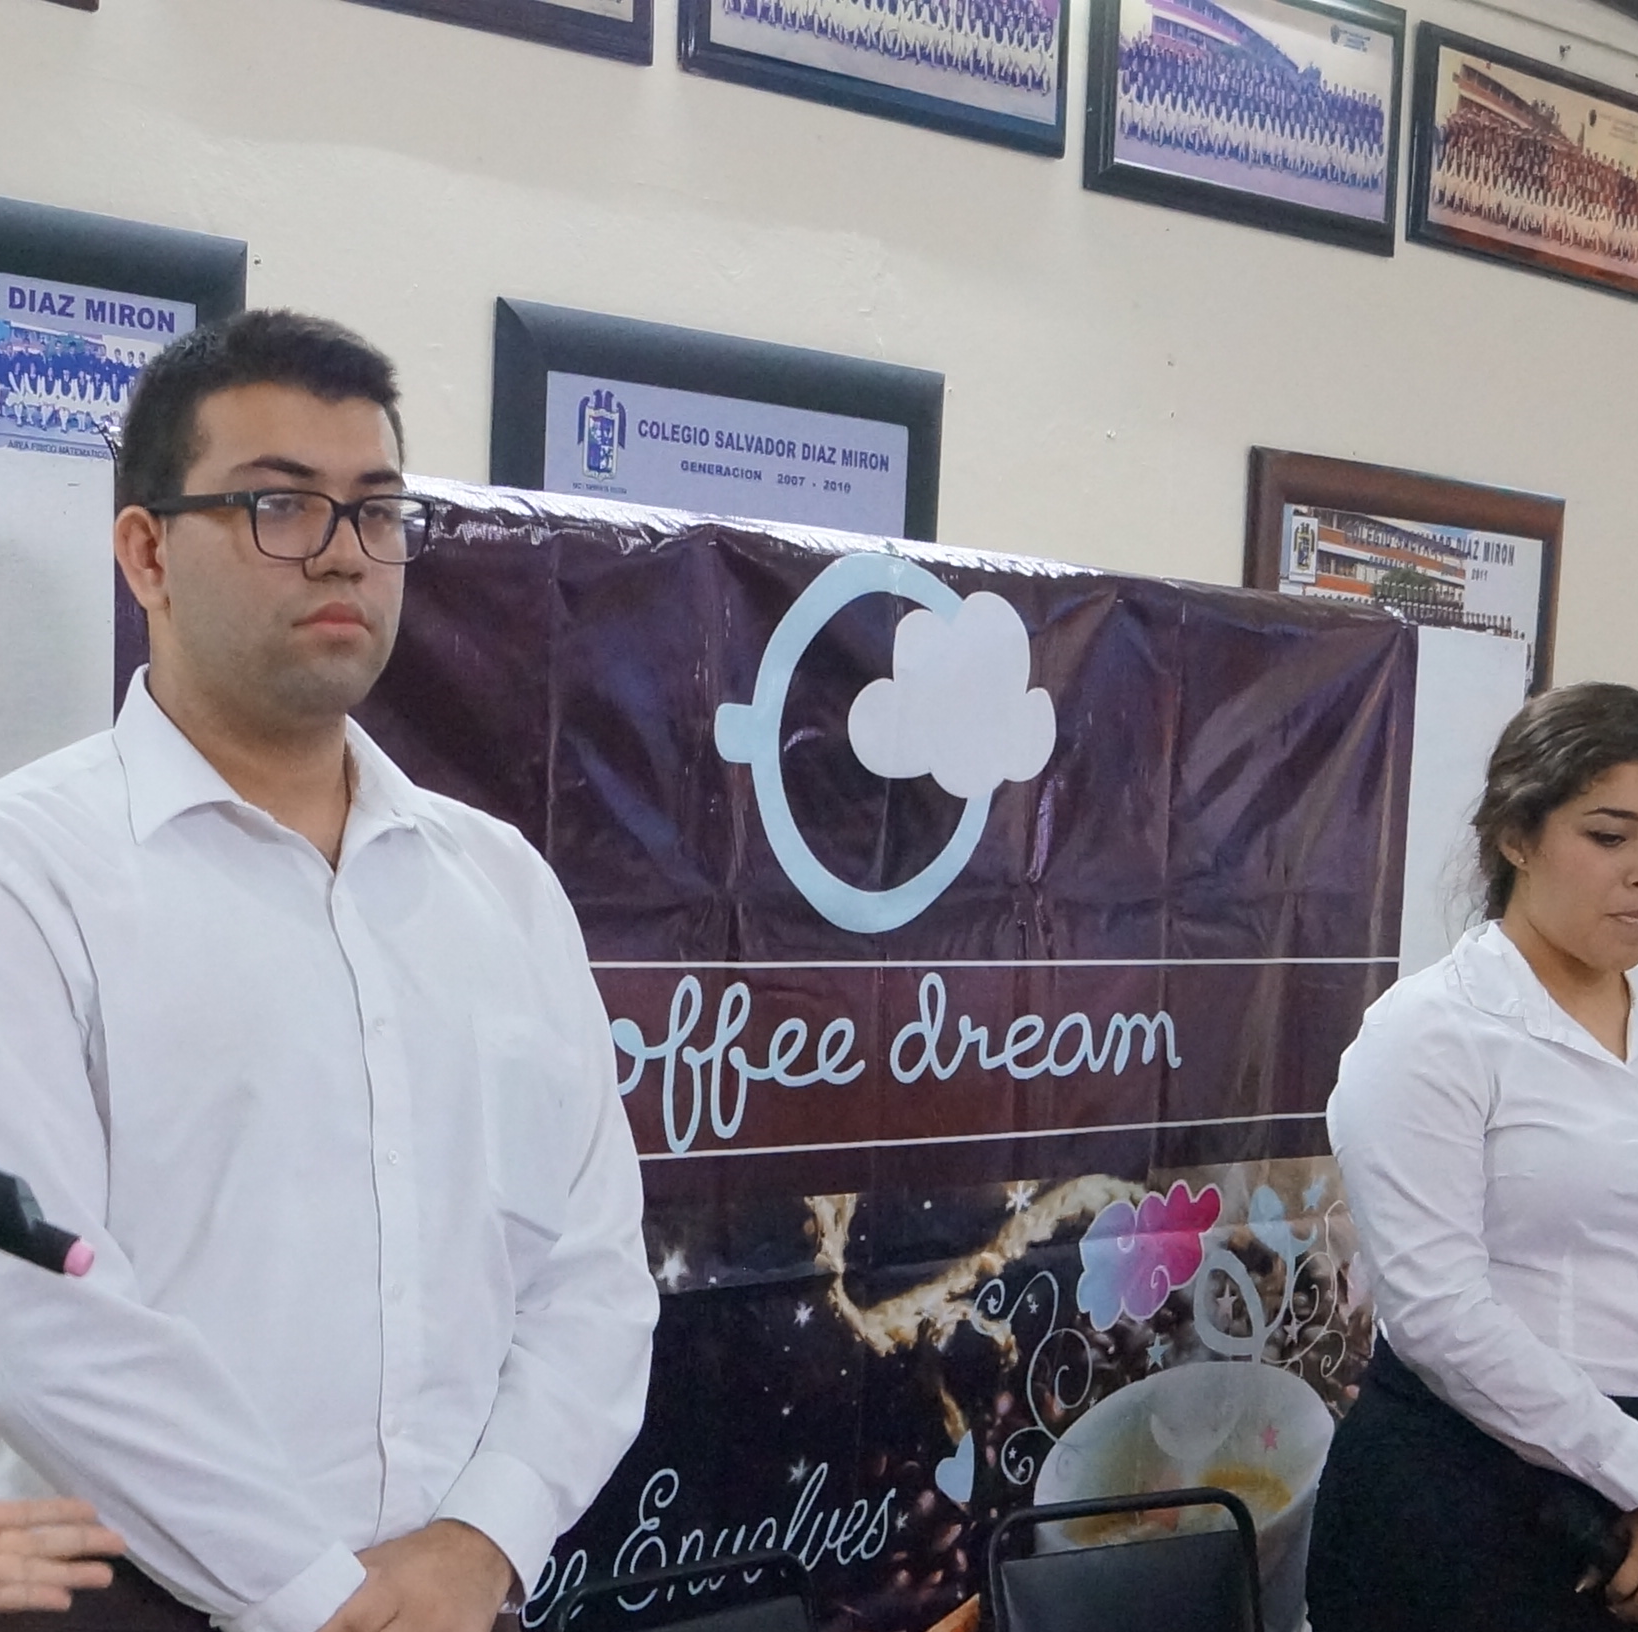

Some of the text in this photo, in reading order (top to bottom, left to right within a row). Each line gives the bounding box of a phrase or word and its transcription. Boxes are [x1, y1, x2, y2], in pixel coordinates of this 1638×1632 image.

[8, 285, 76, 319] DIAZ
[84, 298, 177, 334] MIRON
[637, 418, 890, 473] COLEGIO SALVADOR DIAZ MIRON
[680, 459, 763, 482] GENERACION
[776, 472, 806, 488] 2007
[822, 479, 852, 494] 2010
[1482, 540, 1516, 566] MIRON
[610, 971, 1183, 1154] offee dream
